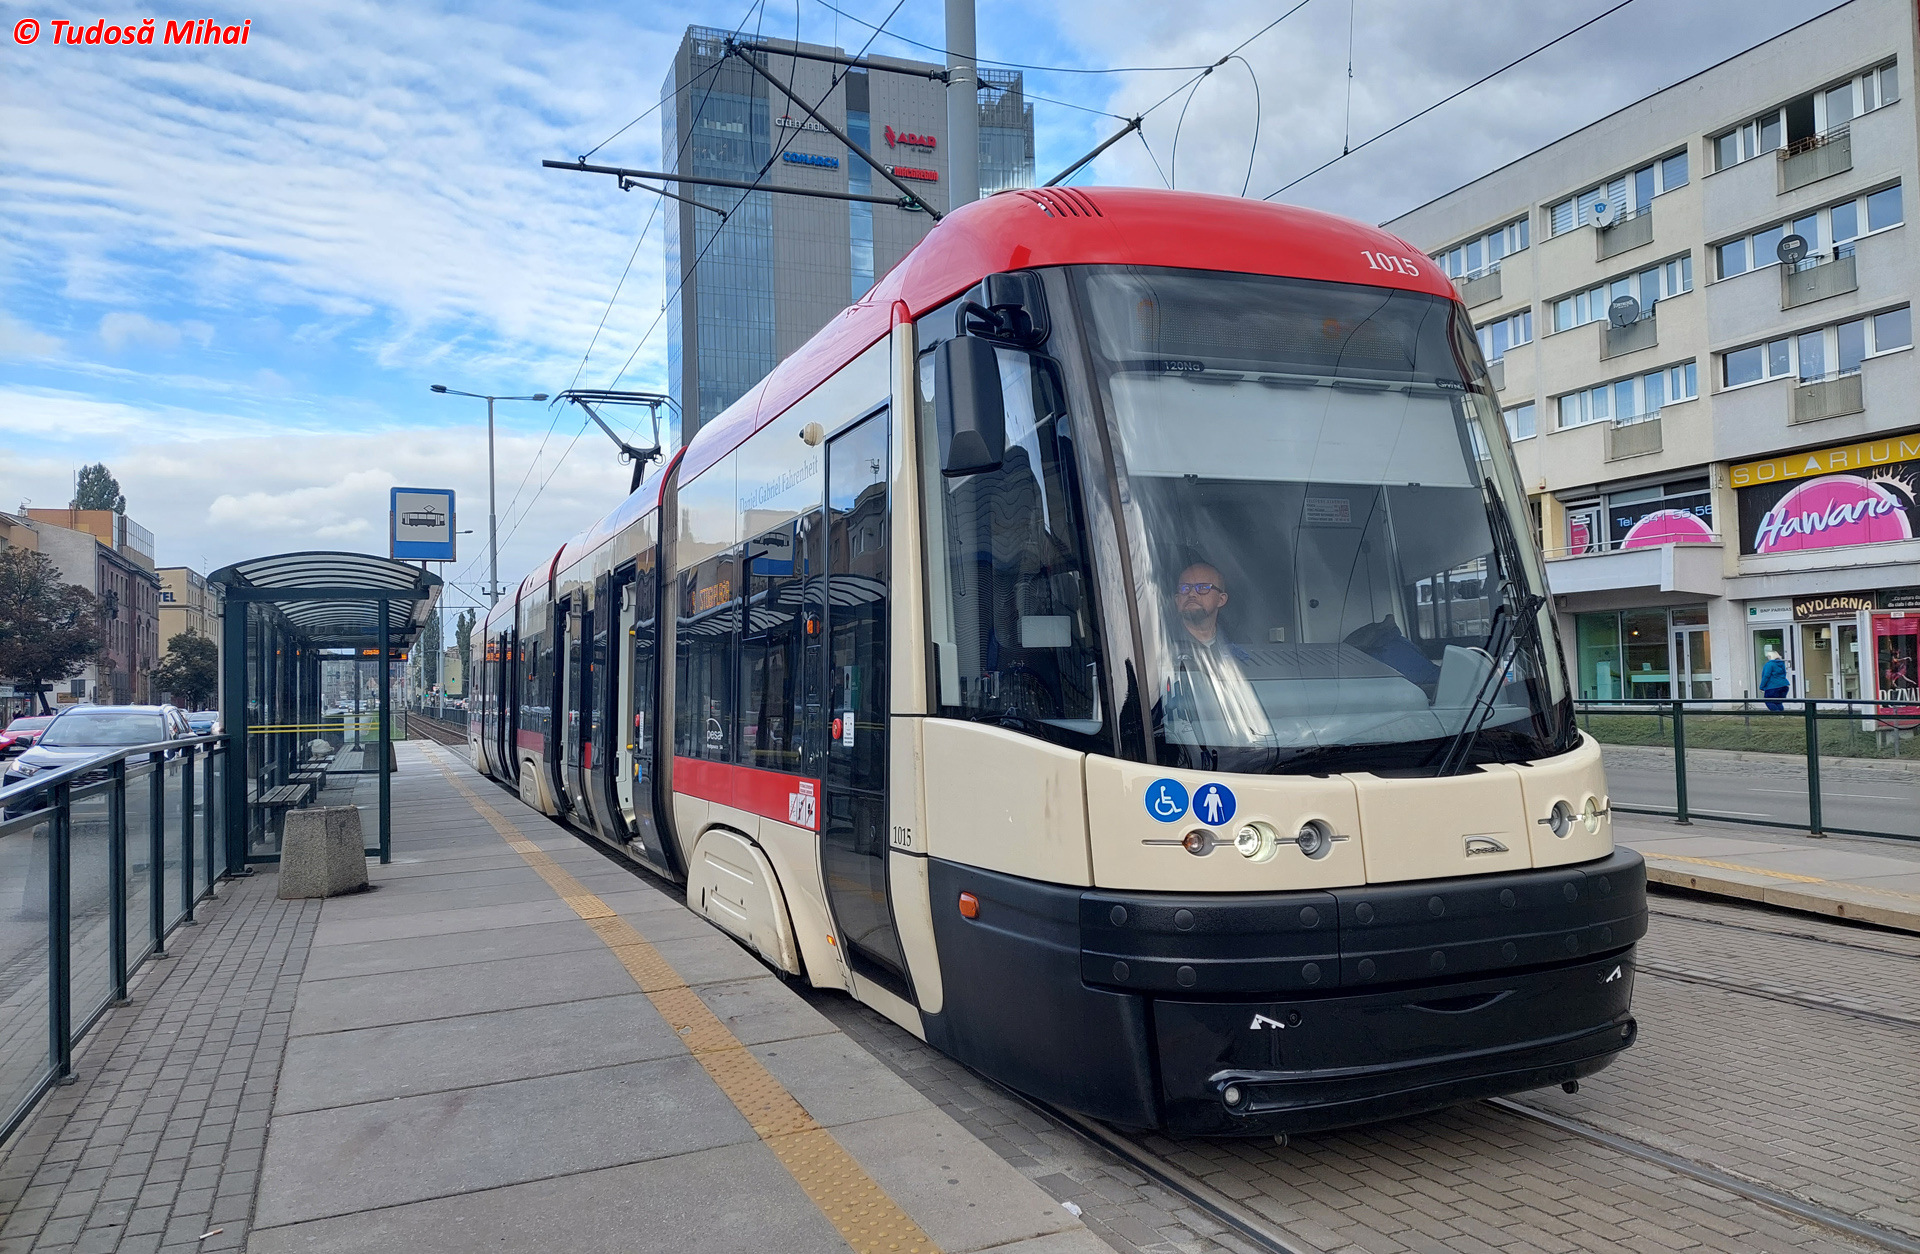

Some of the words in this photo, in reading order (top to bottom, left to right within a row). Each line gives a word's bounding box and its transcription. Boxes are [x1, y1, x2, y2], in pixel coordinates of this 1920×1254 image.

[897, 131, 936, 148] ADAR
[782, 151, 840, 169] COMARCH
[893, 166, 939, 182] MACGREGOR
[1361, 250, 1420, 277] 1015
[1733, 440, 1920, 484] SOLARIUM
[740, 488, 758, 515] Daniel
[758, 476, 781, 504] Gabriel
[782, 455, 818, 493] Fahrenheit
[1617, 516, 1636, 528] Tel.
[1754, 494, 1907, 550] Hawana
[1796, 597, 1873, 617] MYDLARNIA
[893, 825, 912, 847] 1015
